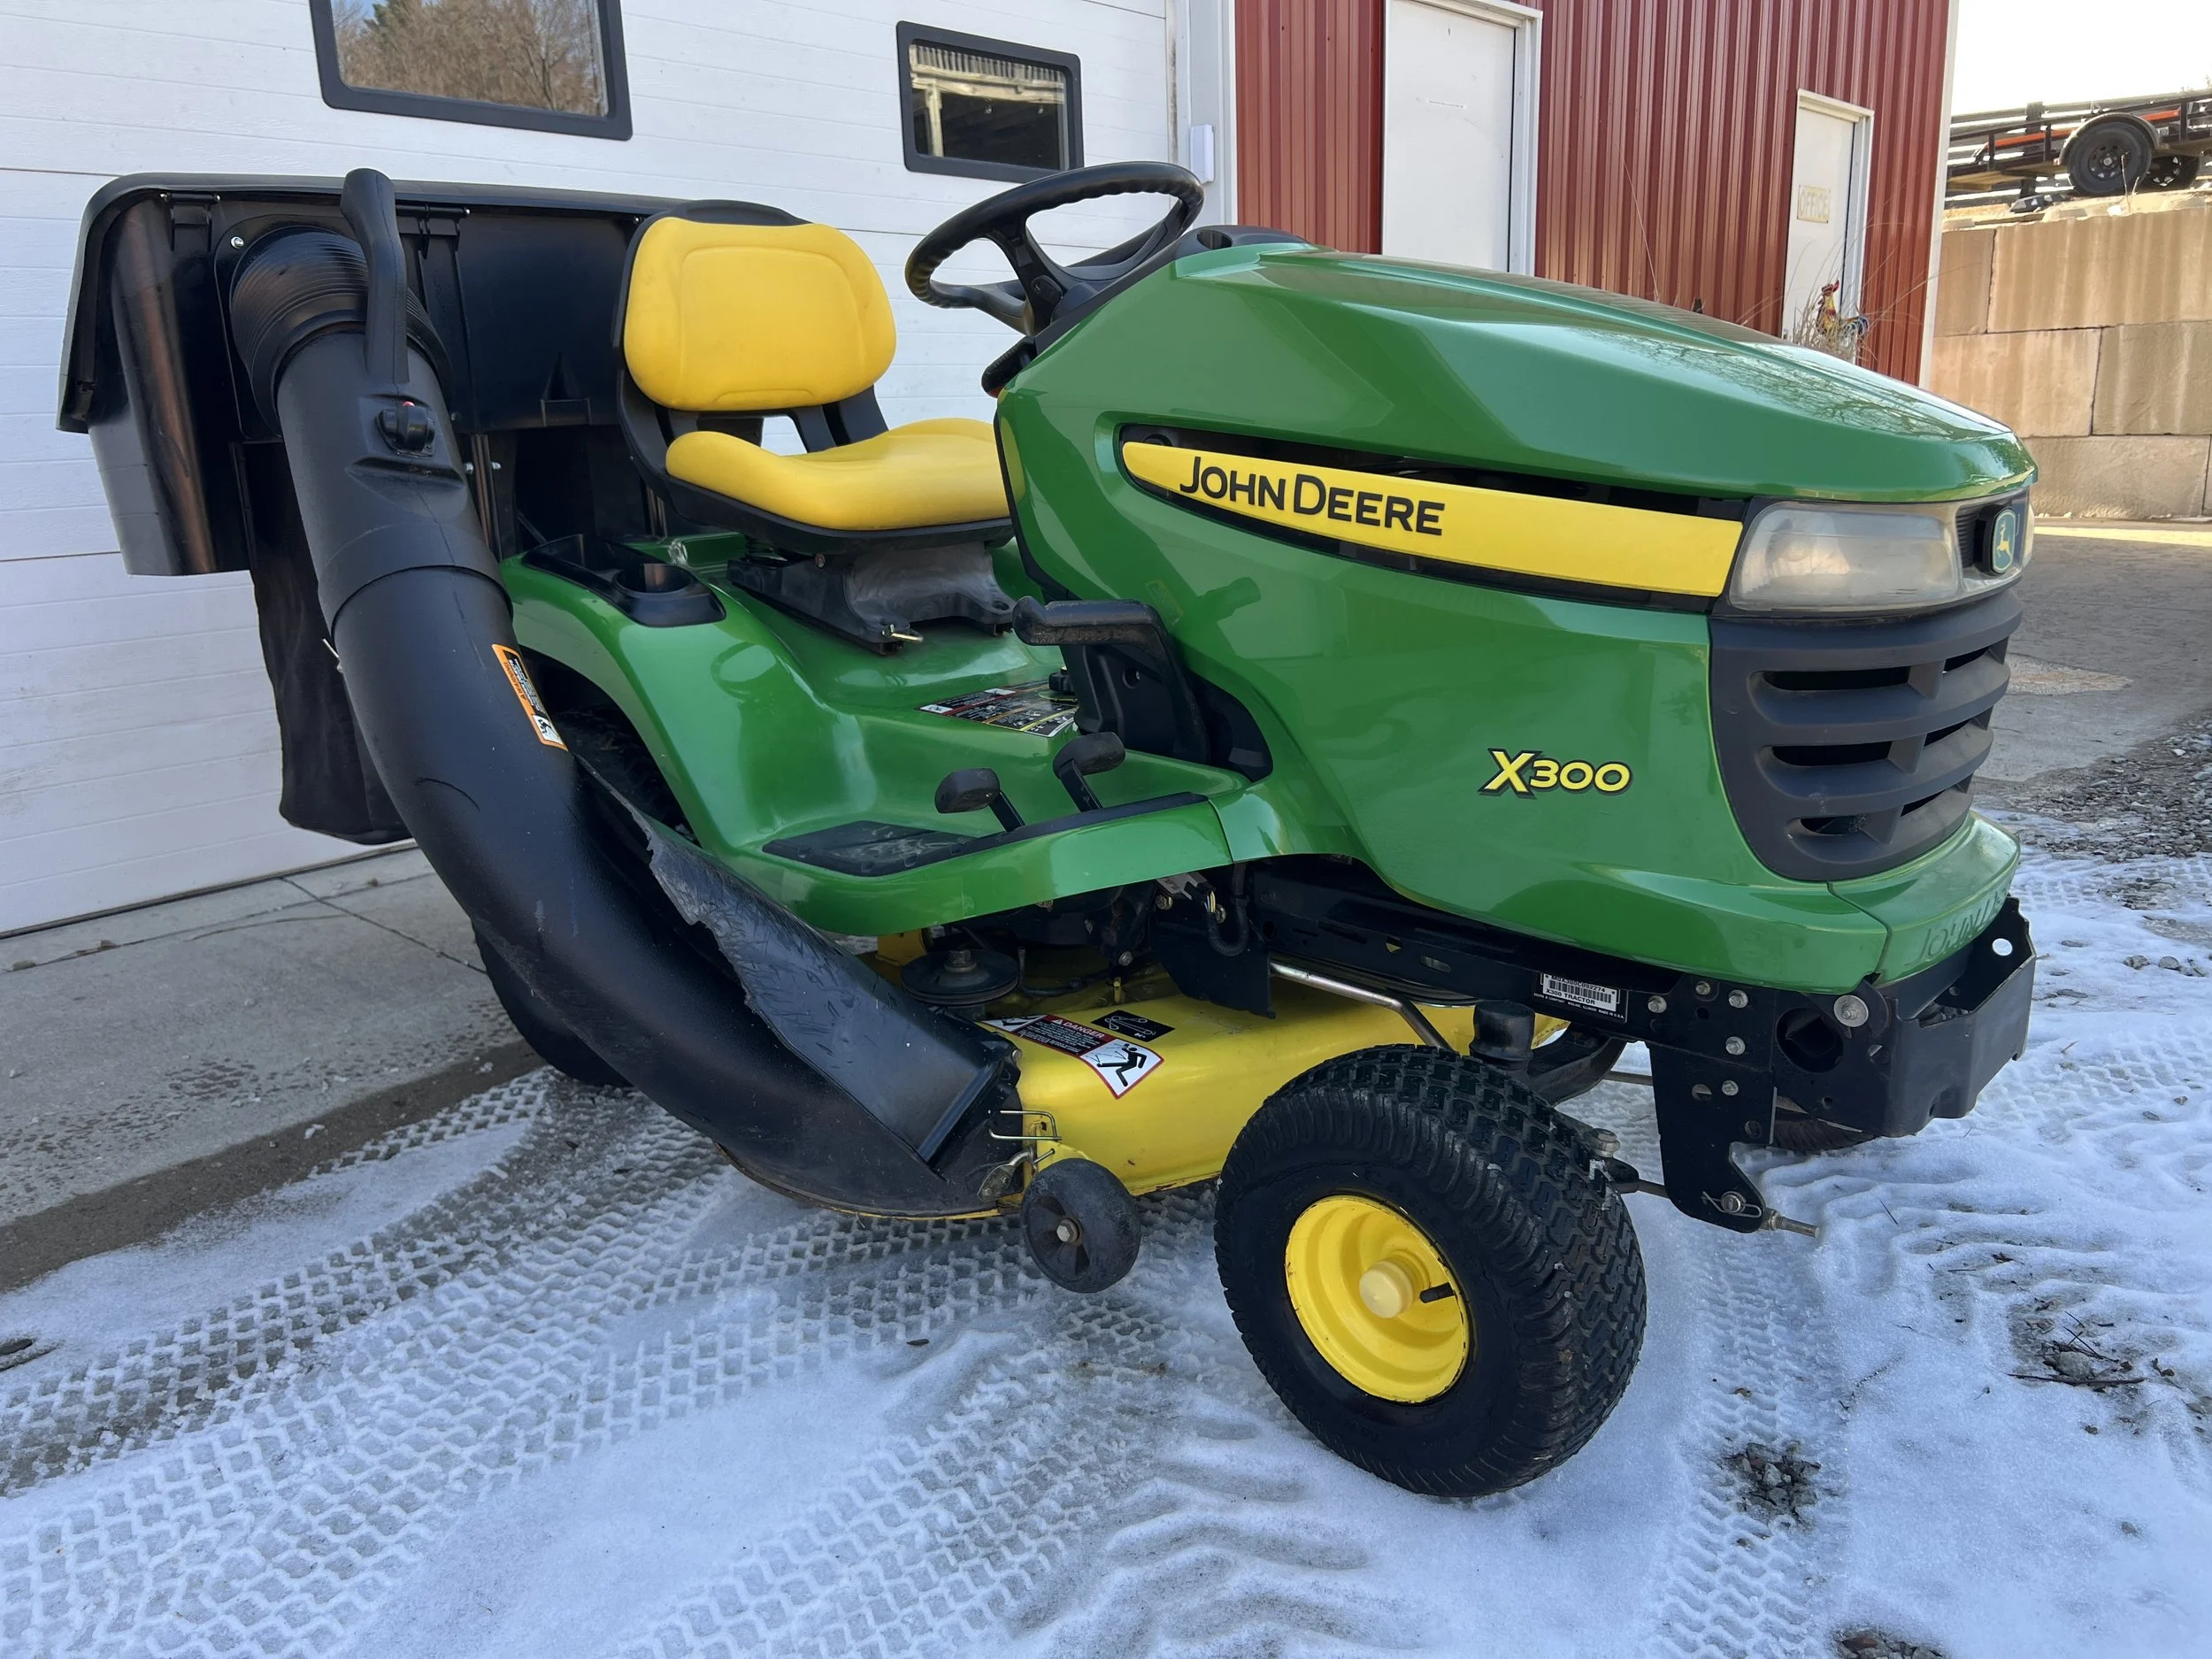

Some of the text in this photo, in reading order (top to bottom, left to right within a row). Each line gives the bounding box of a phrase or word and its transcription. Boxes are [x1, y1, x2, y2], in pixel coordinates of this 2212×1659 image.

[1800, 188, 1828, 219] OFFICE
[1179, 457, 1446, 536] JOHN DEERE
[1477, 748, 1632, 799] X300
[1546, 987, 1595, 1005] X300 TRACTOR
[1062, 1021, 1106, 1039] DANGER
